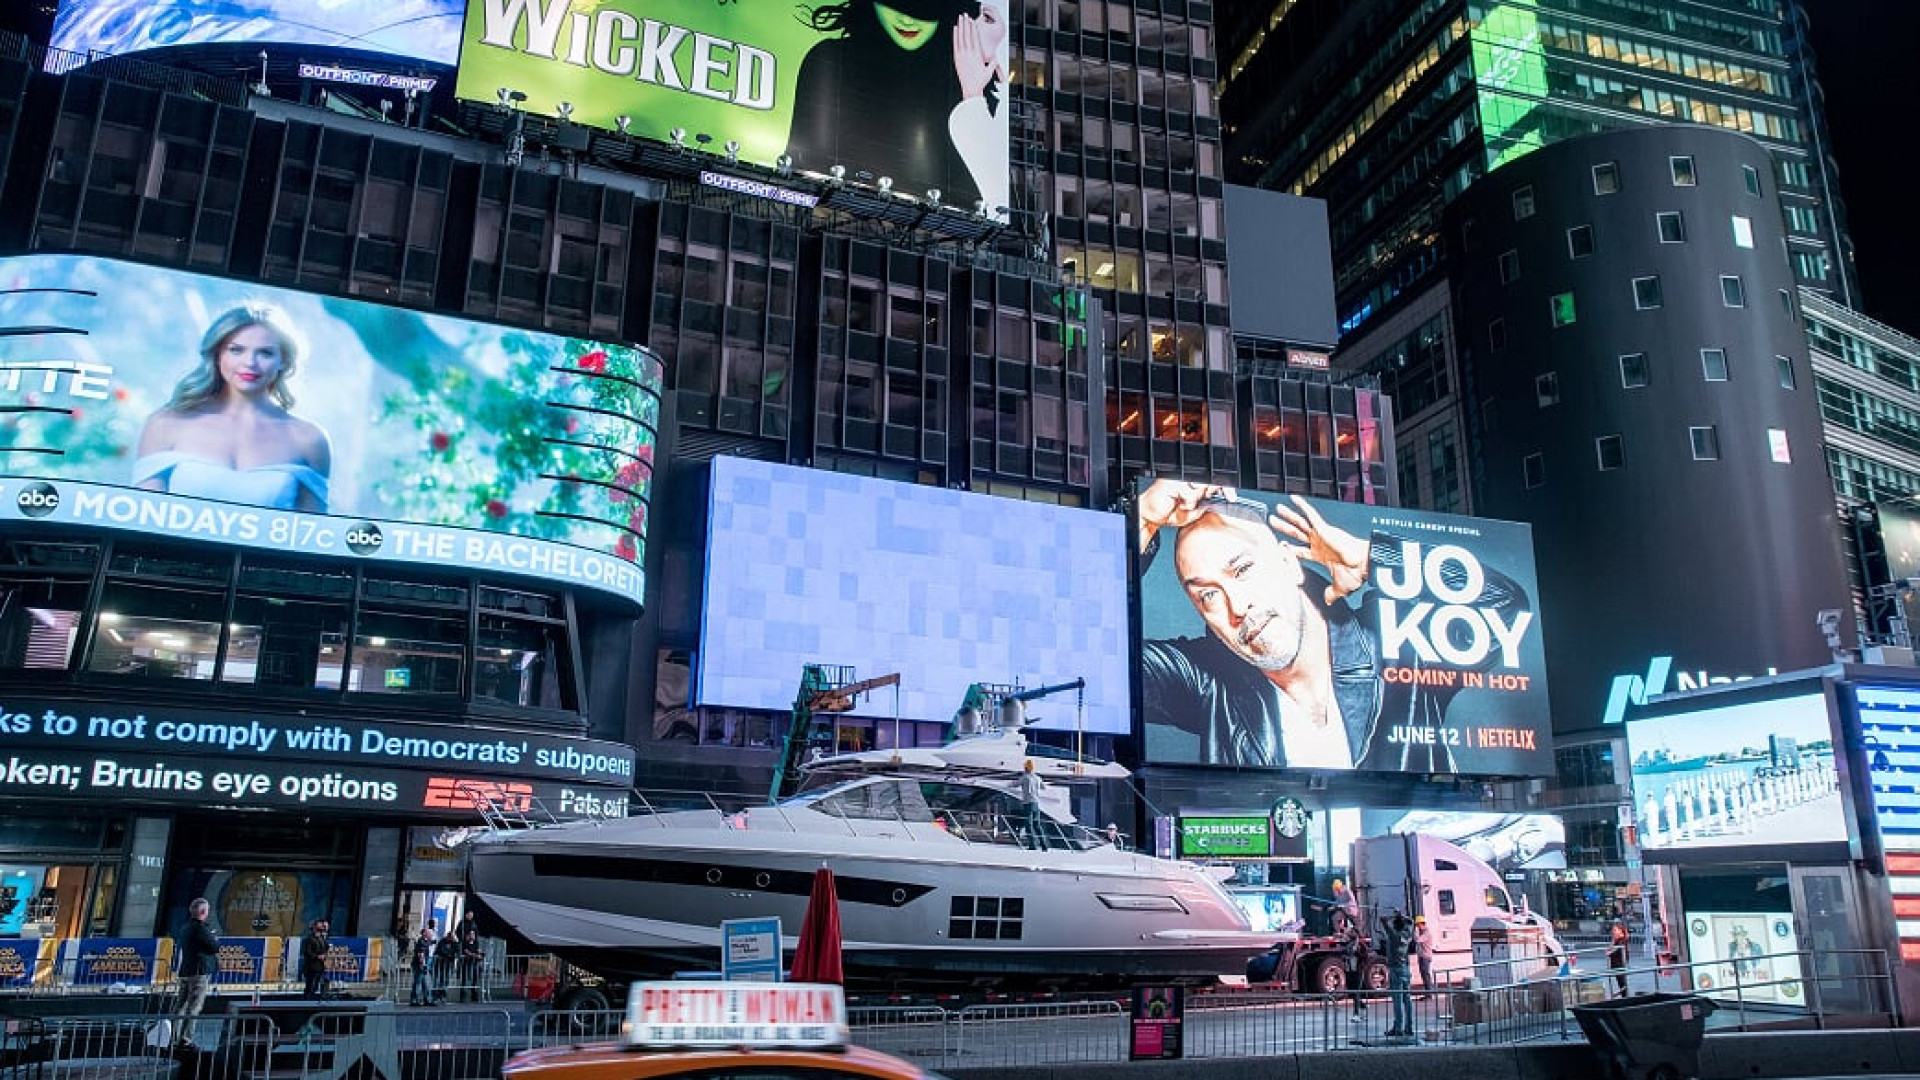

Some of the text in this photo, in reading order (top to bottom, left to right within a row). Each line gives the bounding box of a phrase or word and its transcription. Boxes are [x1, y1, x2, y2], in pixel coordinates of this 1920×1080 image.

[479, 0, 776, 110] WICKED
[18, 489, 58, 507] abc
[73, 490, 259, 539] MONDAYS
[345, 529, 383, 546] abc
[392, 529, 455, 558] THE
[1376, 542, 1484, 604] JO
[1379, 599, 1533, 668] KOY
[1383, 667, 1530, 691] COMIN' IN HOT
[42, 709, 78, 735] to
[88, 715, 148, 739] not
[155, 720, 278, 752] comply
[285, 725, 351, 752] with
[360, 729, 528, 765] Democrats'
[1387, 725, 1536, 750] JUNE 12 NETFLIX
[92, 759, 203, 790] Bruins
[212, 771, 272, 798] eye
[279, 772, 398, 801] options
[424, 777, 533, 812] ESPN
[1184, 825, 1267, 835] STARBUCKS
[642, 989, 724, 1024] PRETTY
[746, 989, 836, 1024] WOMAN
